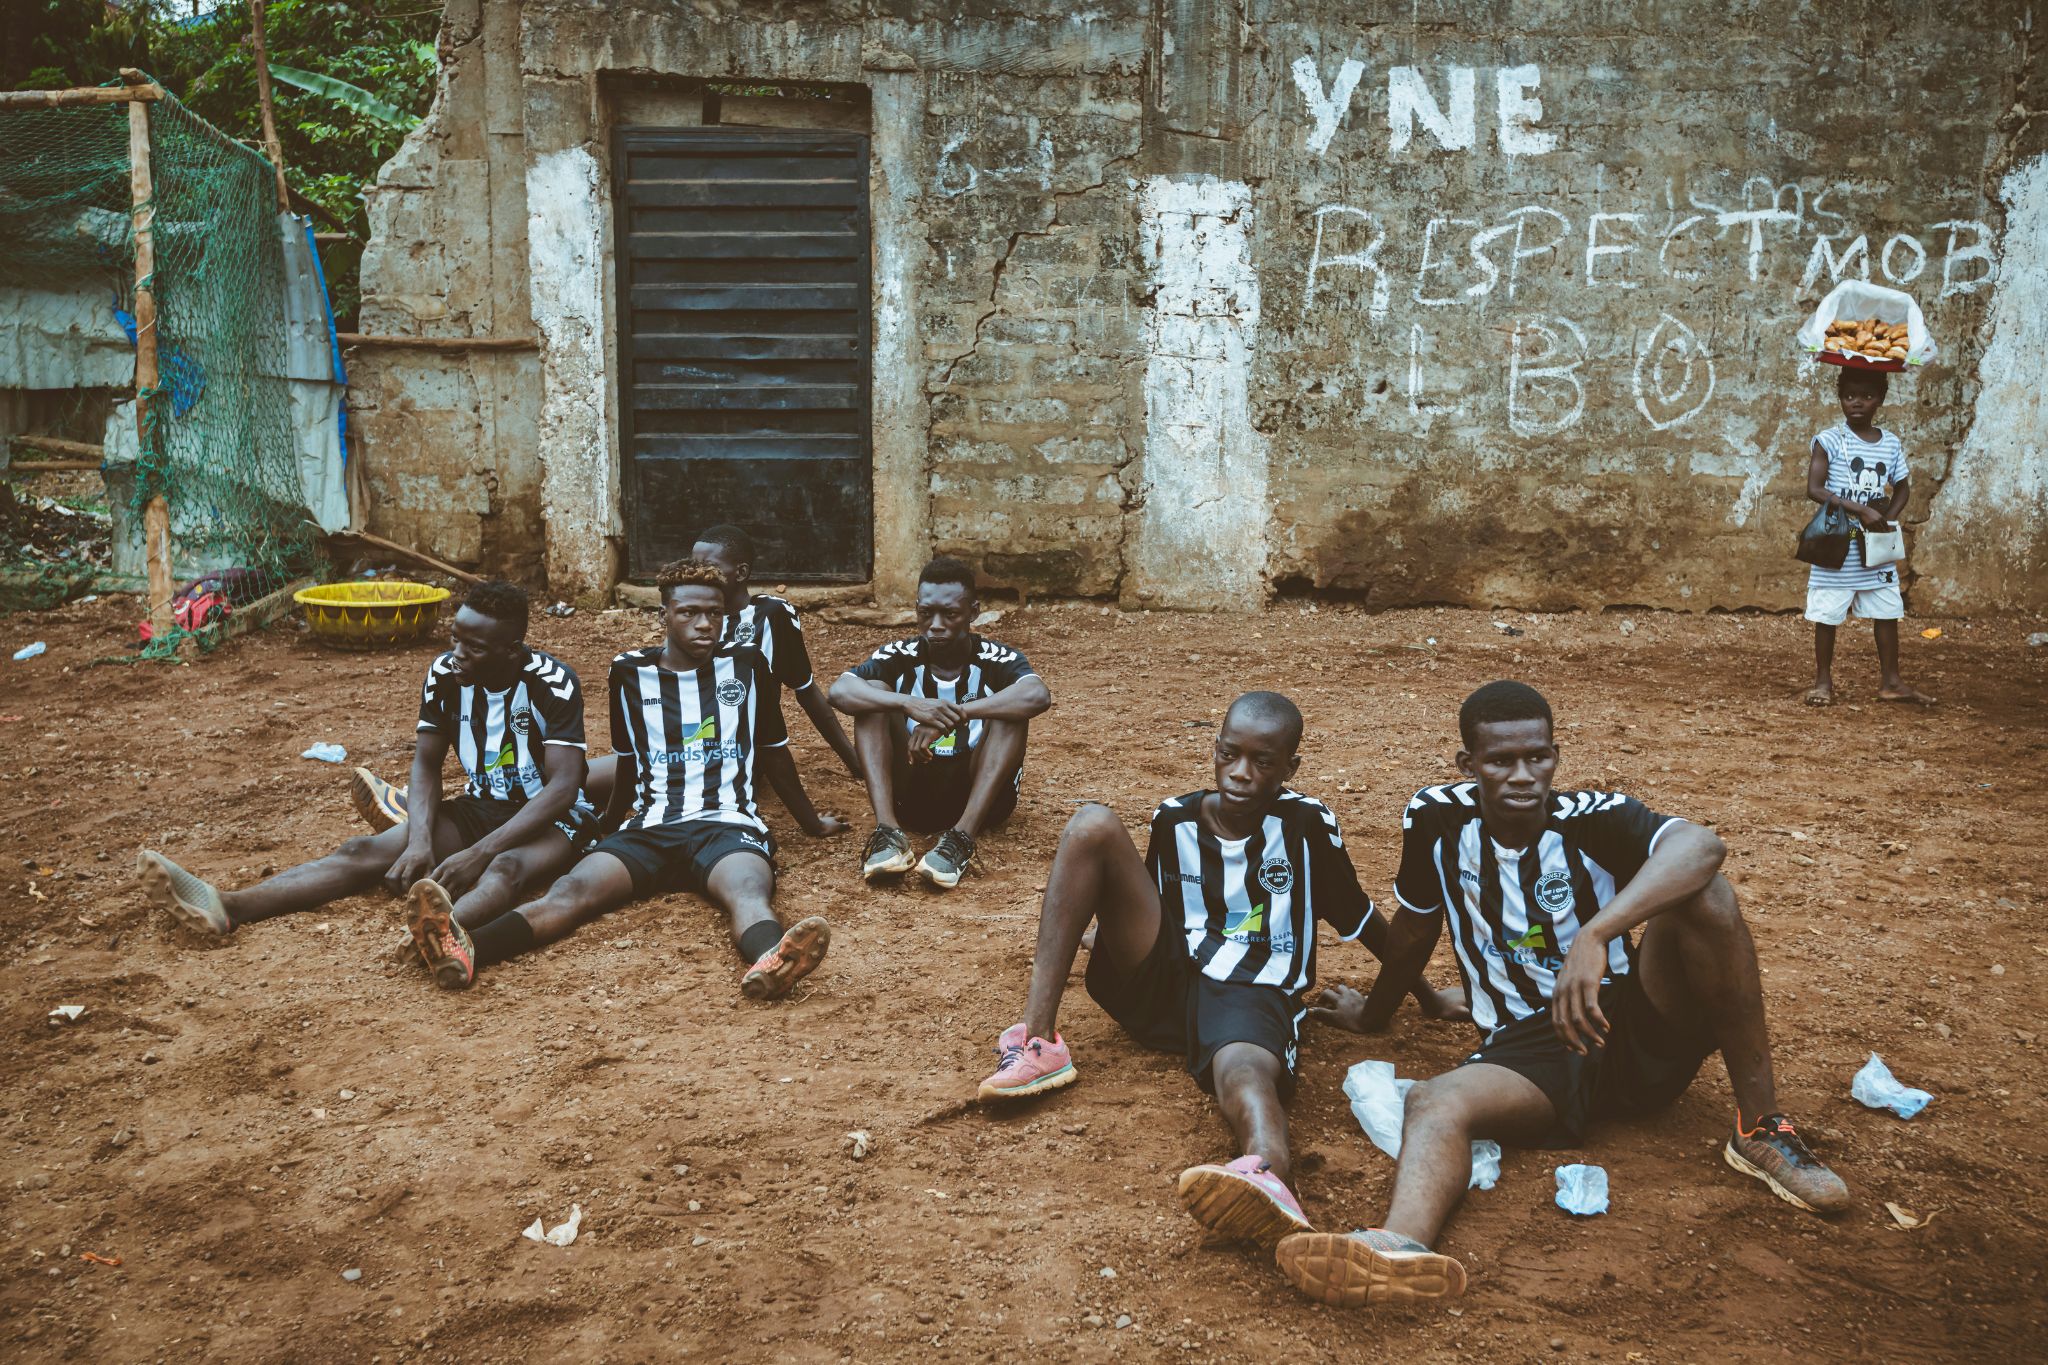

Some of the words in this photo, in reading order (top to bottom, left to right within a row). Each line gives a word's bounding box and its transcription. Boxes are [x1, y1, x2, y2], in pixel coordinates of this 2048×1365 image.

[1290, 57, 1559, 157] YNE
[1302, 198, 1806, 322] RESPECT
[1794, 218, 1999, 305] MOB
[646, 743, 744, 765] Vendsyssel
[1234, 931, 1294, 943] SPAREKASSEN
